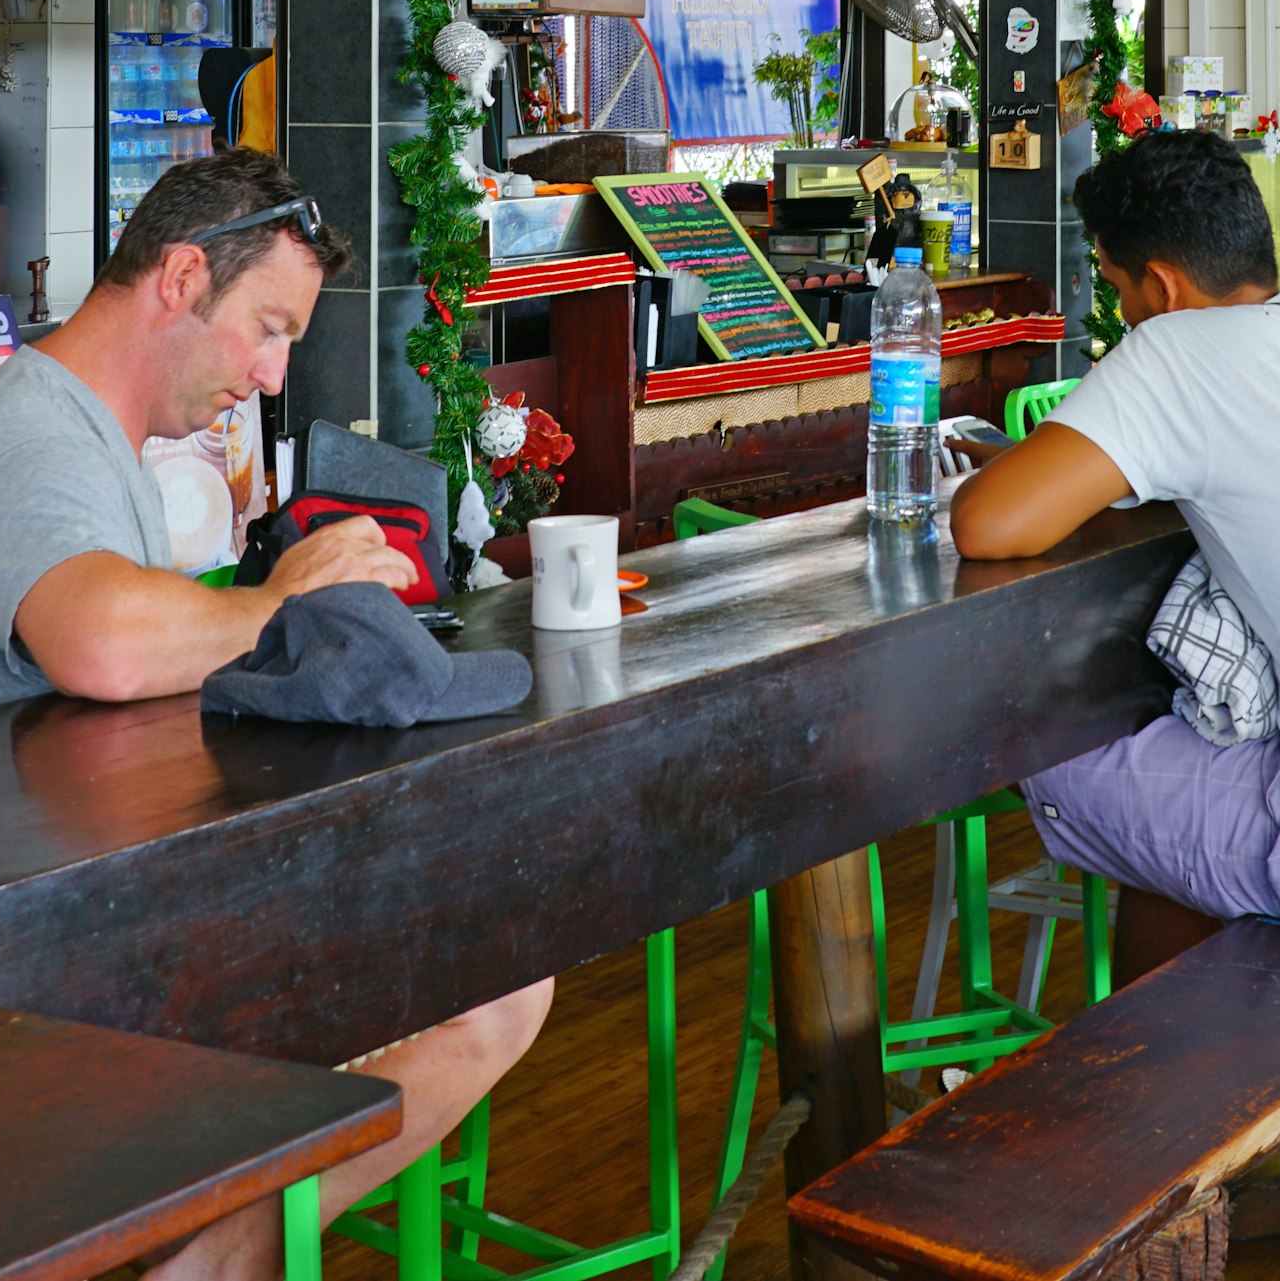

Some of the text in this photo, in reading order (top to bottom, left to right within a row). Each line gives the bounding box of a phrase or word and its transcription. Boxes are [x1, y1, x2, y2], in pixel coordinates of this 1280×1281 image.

[991, 105, 1007, 117] Life
[1017, 105, 1040, 117] Good
[626, 182, 708, 207] SMOOTHIES
